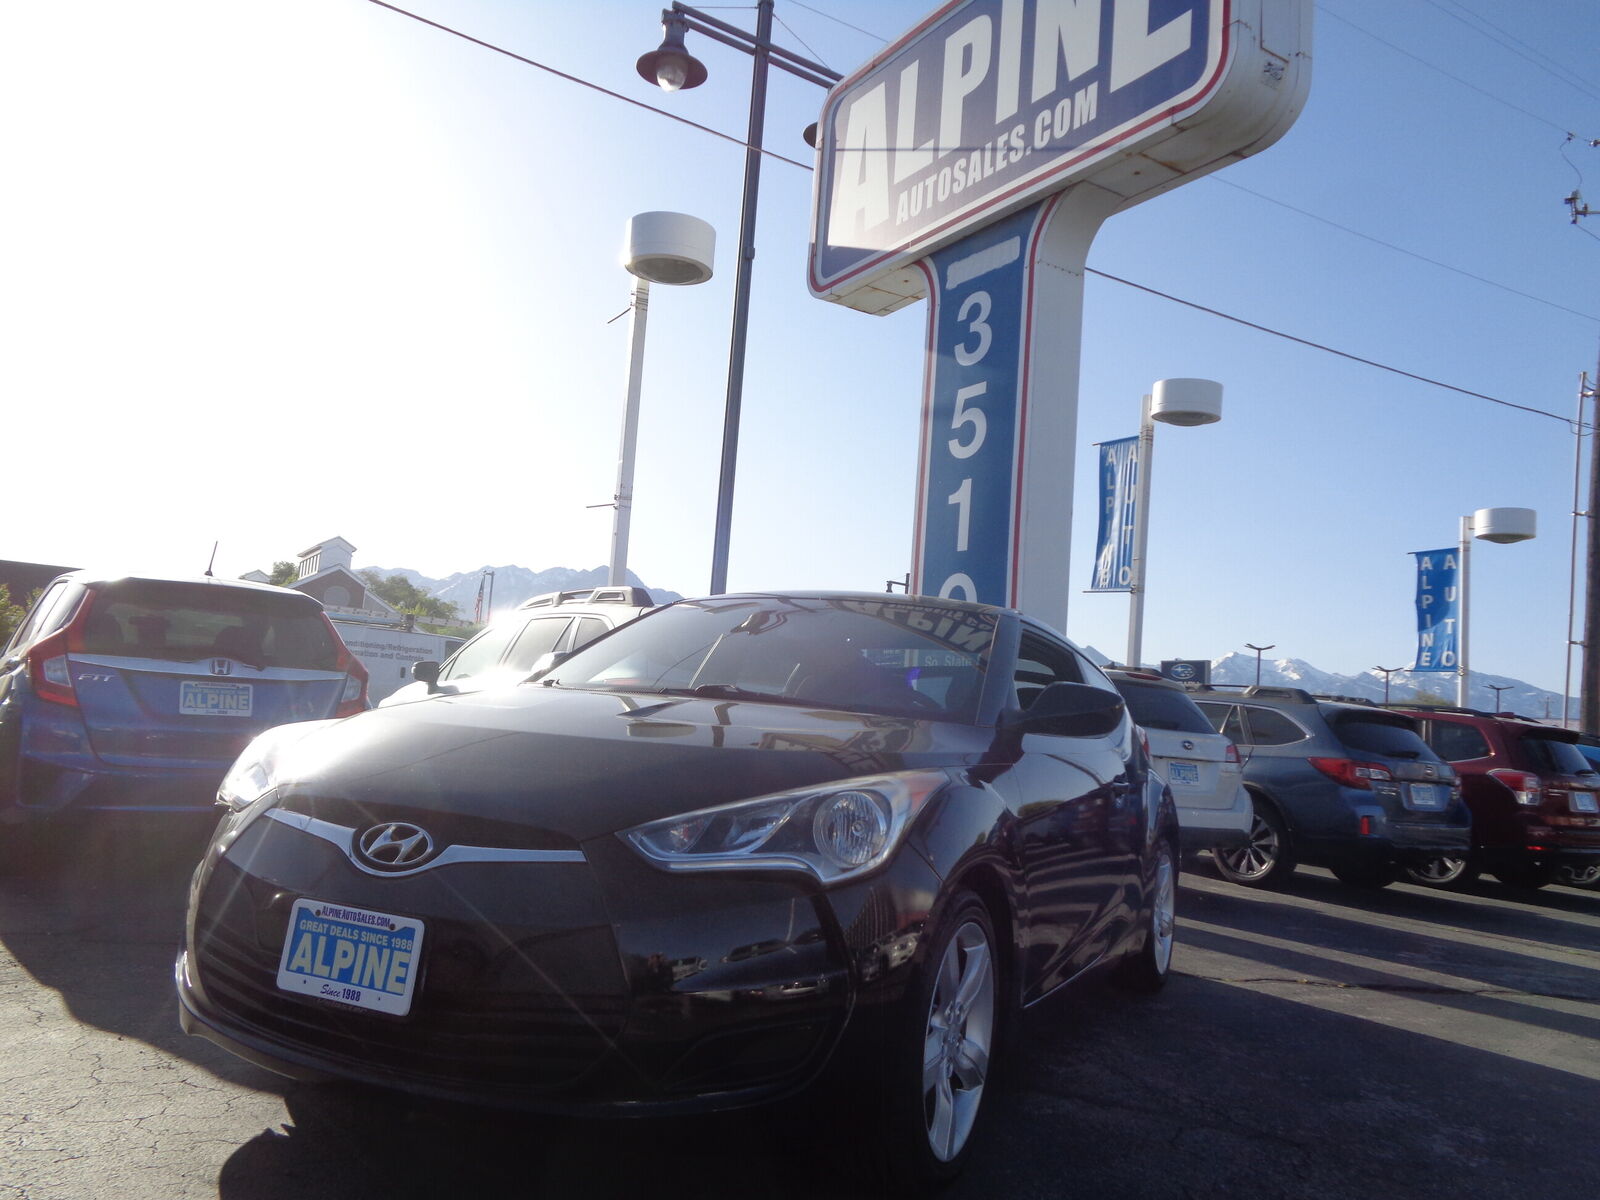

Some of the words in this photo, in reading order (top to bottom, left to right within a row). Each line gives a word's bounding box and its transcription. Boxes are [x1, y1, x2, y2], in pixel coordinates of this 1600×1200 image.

[896, 81, 1098, 226] AUTOSALES.COM
[1420, 556, 1434, 667] ALPINE
[1442, 554, 1457, 667] AUTO
[344, 640, 433, 655] onditioning/Refrigeration
[184, 692, 249, 709] ALPINE
[300, 919, 328, 935] GREAT
[329, 925, 359, 940] DEALS
[361, 931, 388, 947] SINCE
[391, 937, 413, 950] 1988
[289, 932, 412, 994] ALPINE
[320, 983, 342, 998] Since
[341, 988, 361, 1002] 1988
